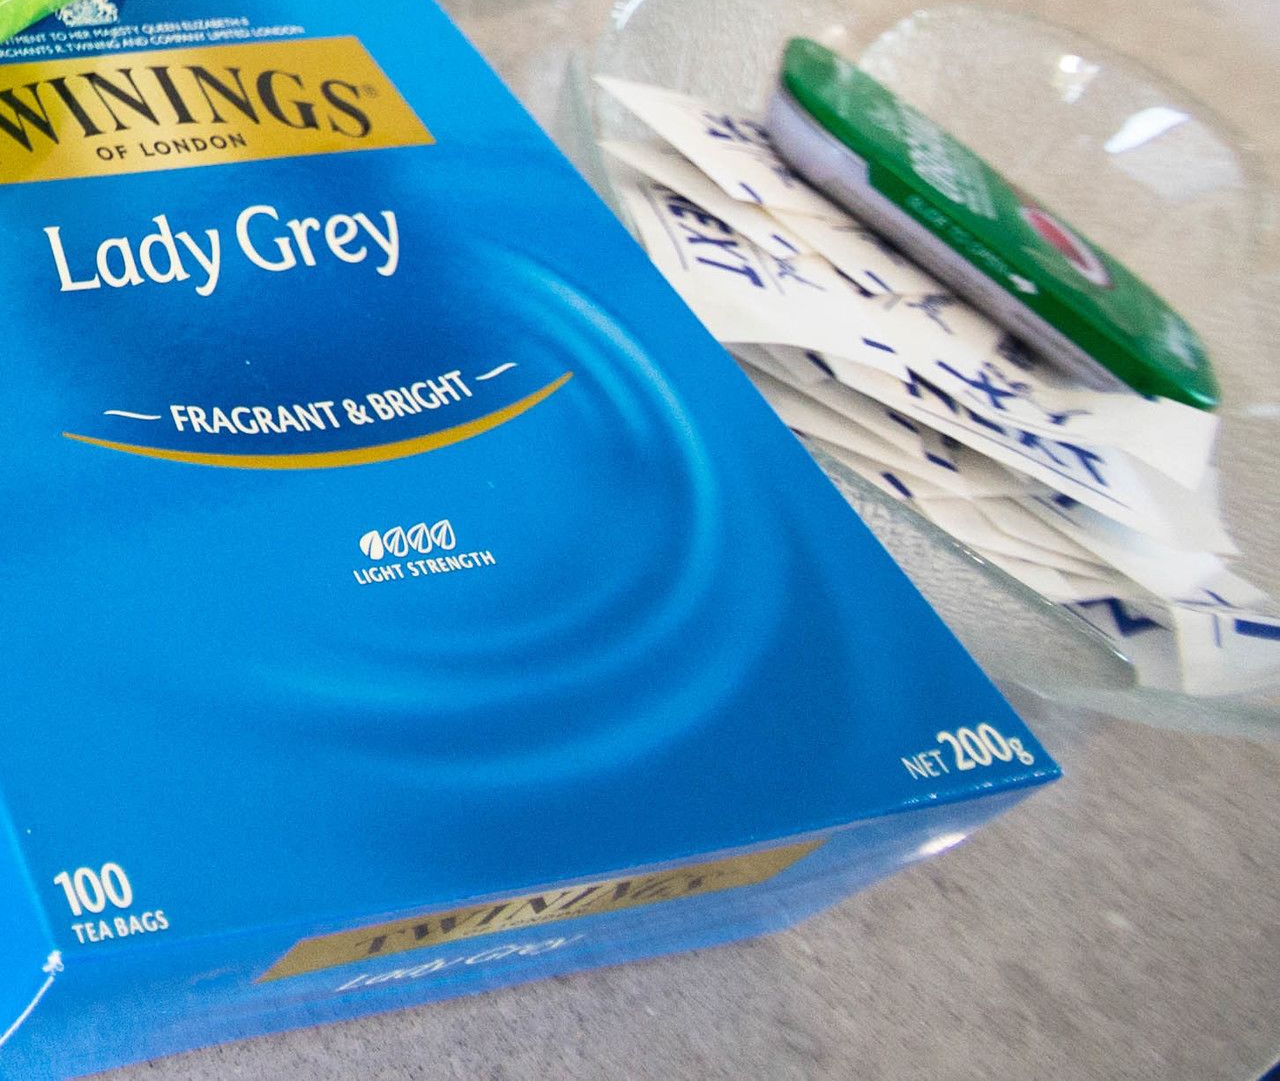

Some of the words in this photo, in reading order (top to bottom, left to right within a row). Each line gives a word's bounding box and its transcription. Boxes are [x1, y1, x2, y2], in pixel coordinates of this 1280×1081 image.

[68, 39, 121, 53] TWINING
[95, 145, 127, 163] OF
[138, 131, 249, 160] LONDON
[43, 214, 223, 297] Lady
[235, 203, 400, 277] Grey
[169, 401, 342, 435] FRAGRANT
[342, 398, 374, 426] &
[367, 369, 474, 424] BRIGHT
[352, 562, 405, 586] LIGHT
[406, 549, 497, 579] STRENGTH
[899, 749, 950, 781] NET
[935, 721, 1036, 772] 200g
[52, 862, 134, 918] 100
[71, 919, 116, 945] TEA
[113, 909, 171, 939] BAGS
